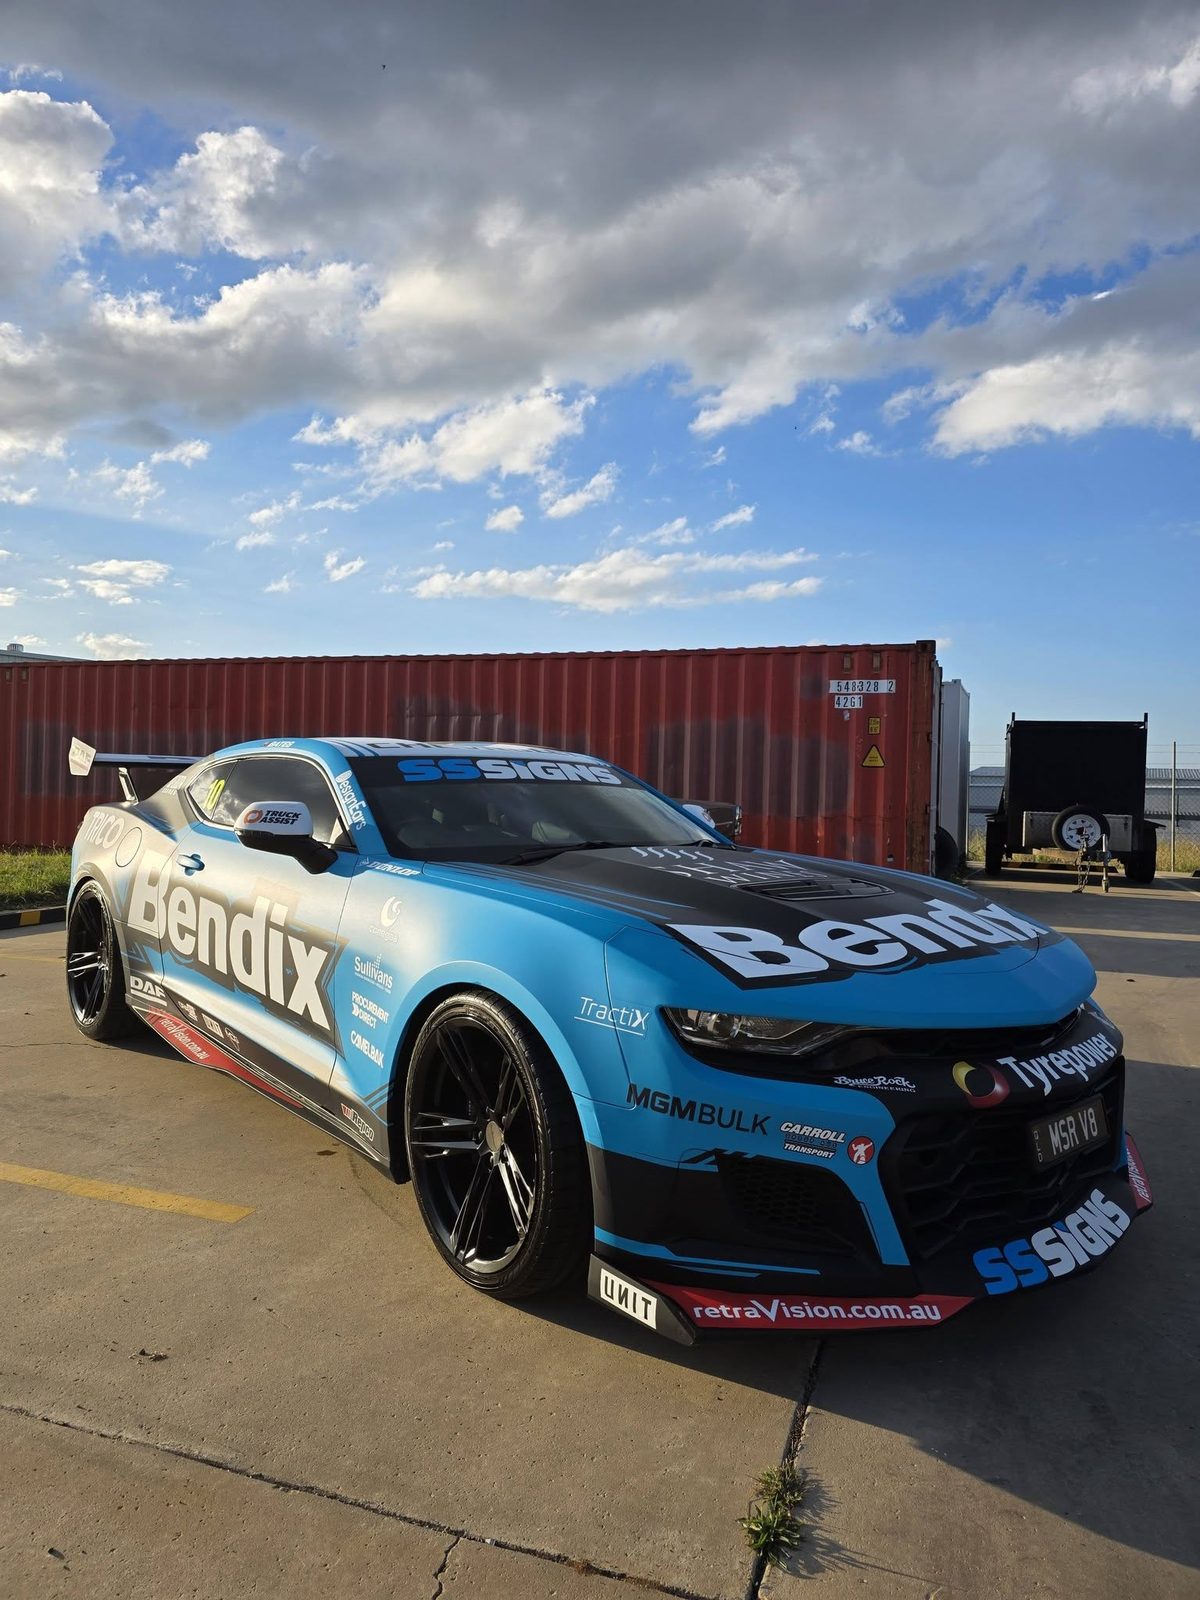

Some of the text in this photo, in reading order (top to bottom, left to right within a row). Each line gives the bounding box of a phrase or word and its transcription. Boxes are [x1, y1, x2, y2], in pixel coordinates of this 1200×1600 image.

[836, 680, 894, 692] 548328 2
[835, 696, 862, 708] 42G1
[203, 779, 225, 811] 10
[259, 816, 298, 825] ASSIST
[264, 810, 302, 819] TRUCK
[84, 811, 125, 849] TRICO
[367, 861, 421, 876] DUNLOP
[127, 849, 331, 1031] Bendix
[665, 898, 1050, 979] Bendix
[354, 956, 393, 989] Sullivans
[130, 975, 166, 998] DAF
[351, 991, 390, 1025] PROCUREMENT
[358, 1008, 377, 1029] DIRECT
[580, 996, 650, 1030] TractiX
[350, 1030, 385, 1069] CAMELBAK
[996, 1032, 1118, 1097] Tyrepower
[833, 1075, 916, 1088] Bruce Rock
[780, 1122, 847, 1143] CARROLL
[1048, 1107, 1099, 1156] MSR V8
[783, 1143, 836, 1160] TRANSPORT
[692, 1298, 942, 1323] retraVision.com.au
